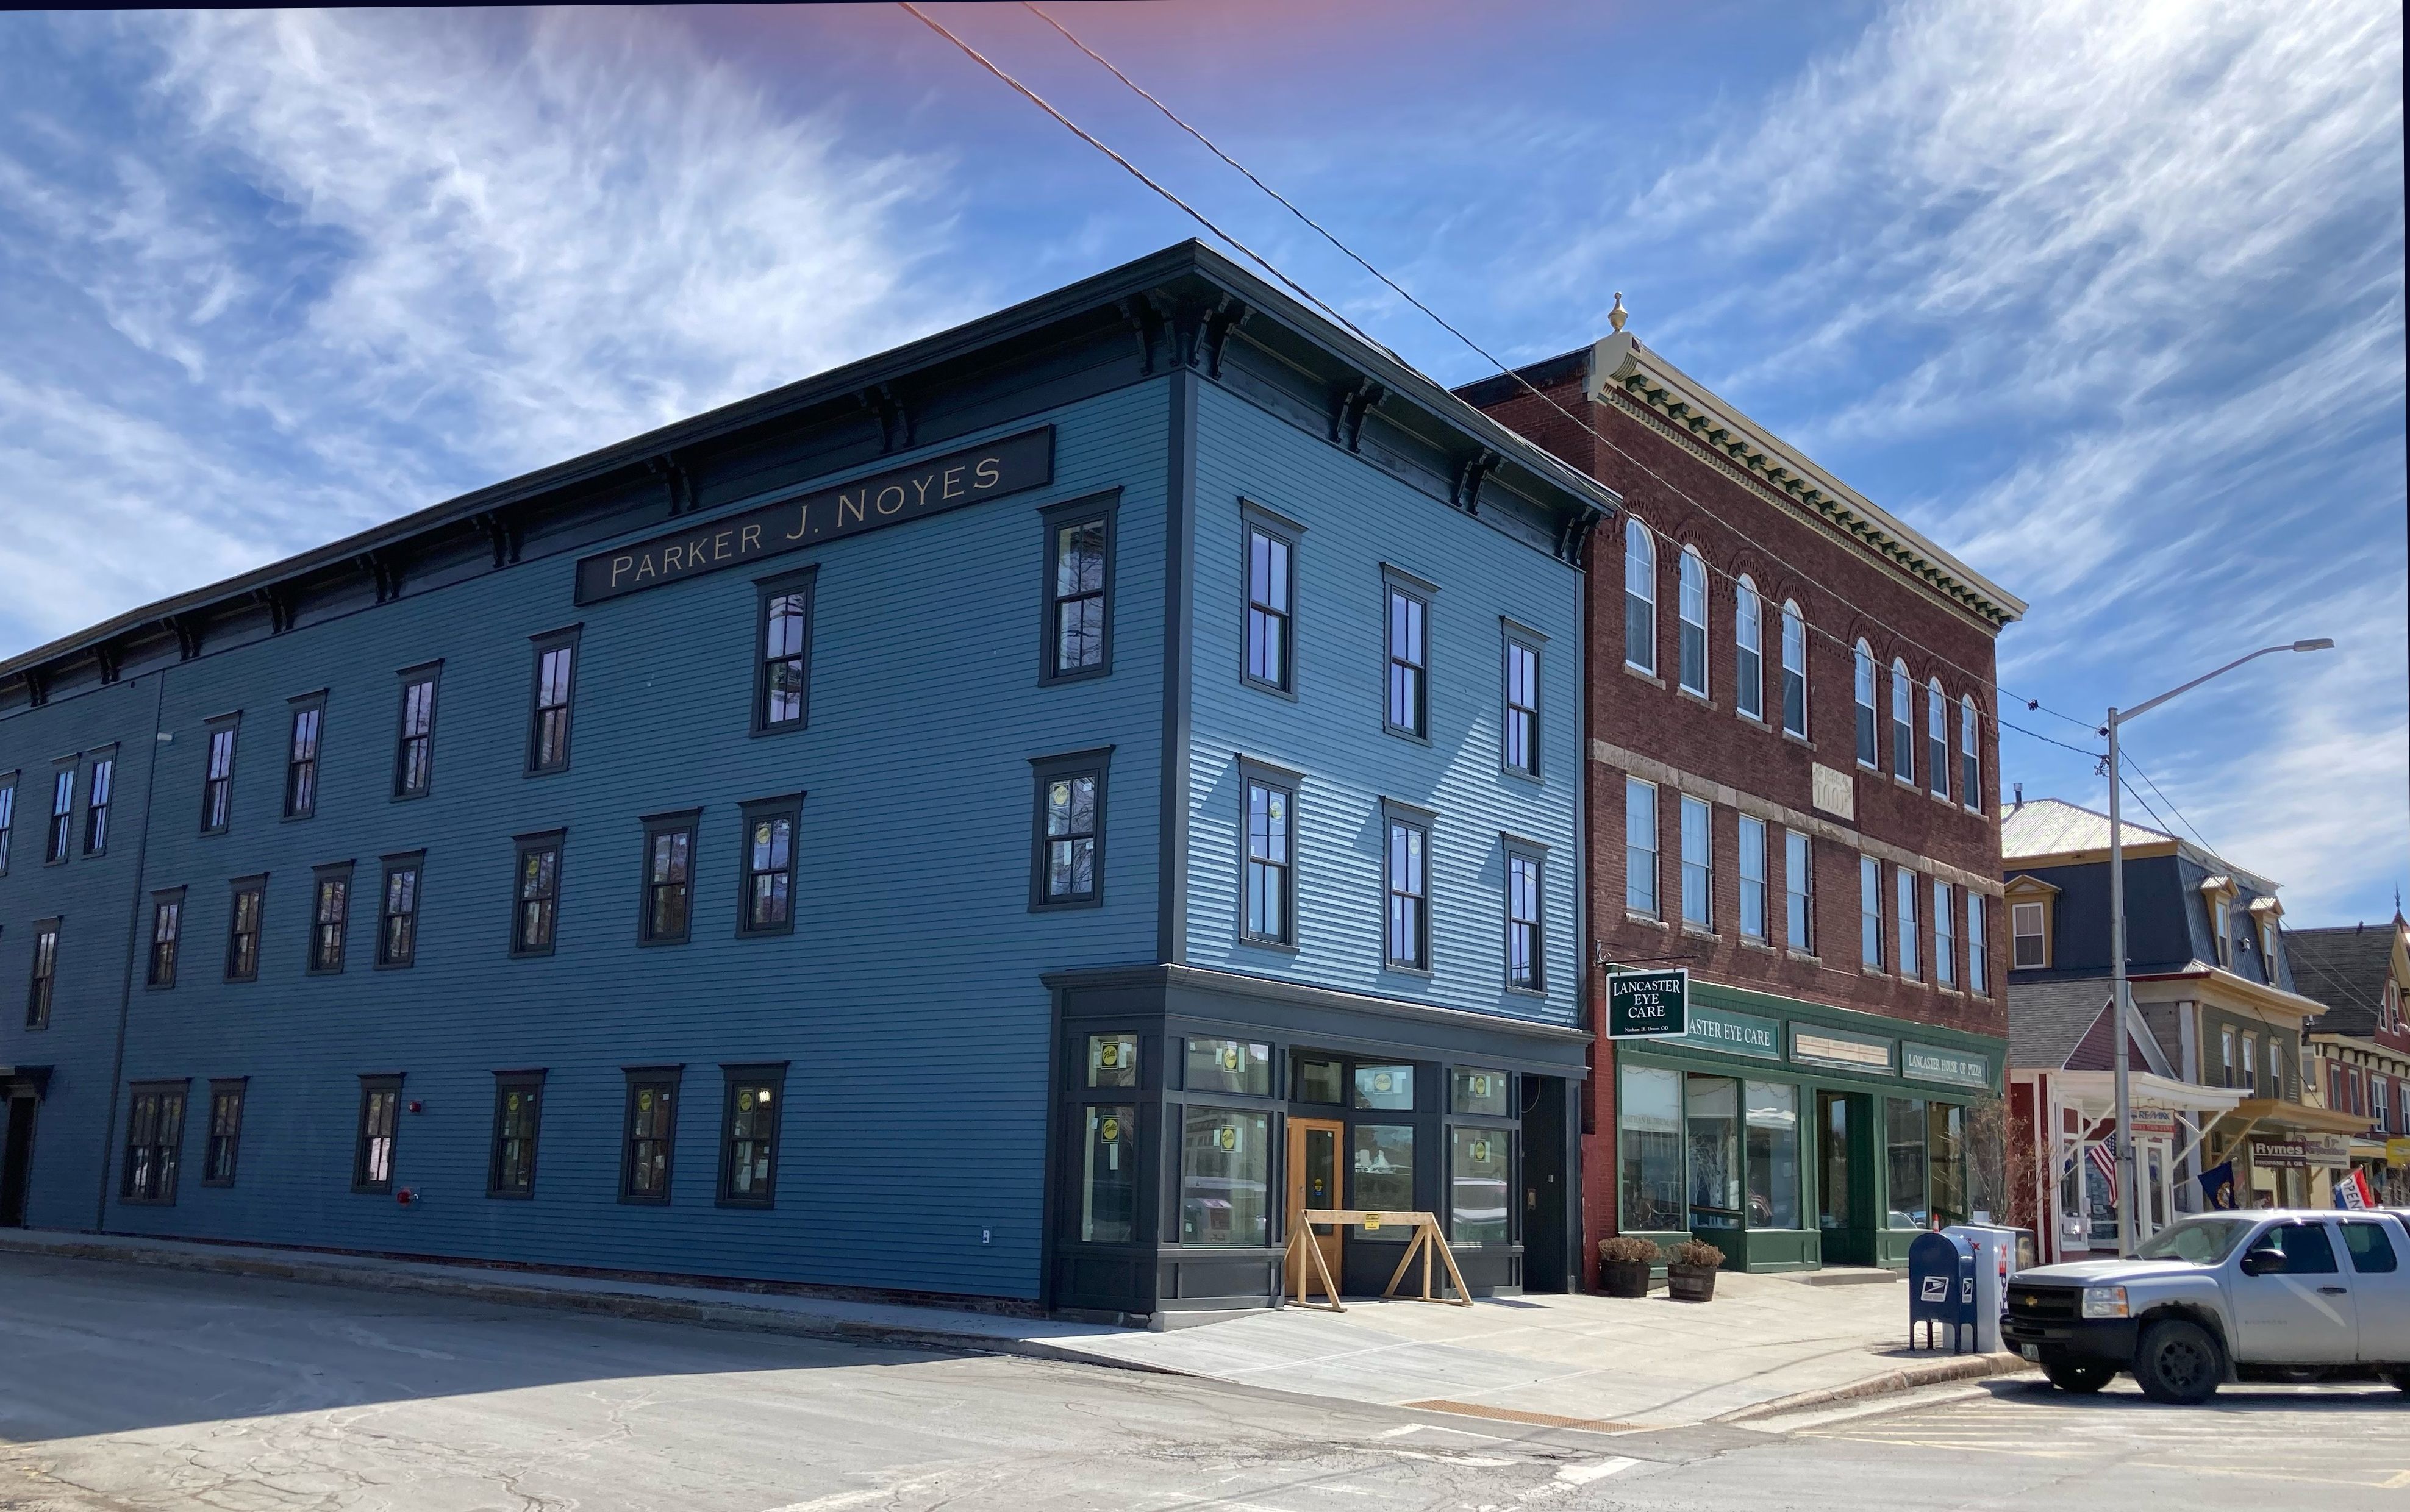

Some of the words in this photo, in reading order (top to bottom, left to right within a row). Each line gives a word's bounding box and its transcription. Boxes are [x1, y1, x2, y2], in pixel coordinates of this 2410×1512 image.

[610, 524, 762, 588] PARKER
[785, 504, 820, 541] J.
[837, 457, 1001, 528] NOYES
[1613, 979, 1681, 997] LANCASTER
[1634, 993, 1659, 1005] EYE
[1628, 1005, 1665, 1018] CARE
[1689, 1018, 1722, 1038] ASTER
[1724, 1024, 1742, 1042] EYE
[1744, 1028, 1770, 1046] CARE
[1908, 1054, 1941, 1071] LANCASTER
[1941, 1059, 1958, 1073] HOUSE
[1960, 1063, 1967, 1074] OF
[1967, 1063, 1982, 1077] PIZZA
[2139, 1111, 2170, 1120] RE/MAX
[2256, 1143, 2303, 1155] Rymes
